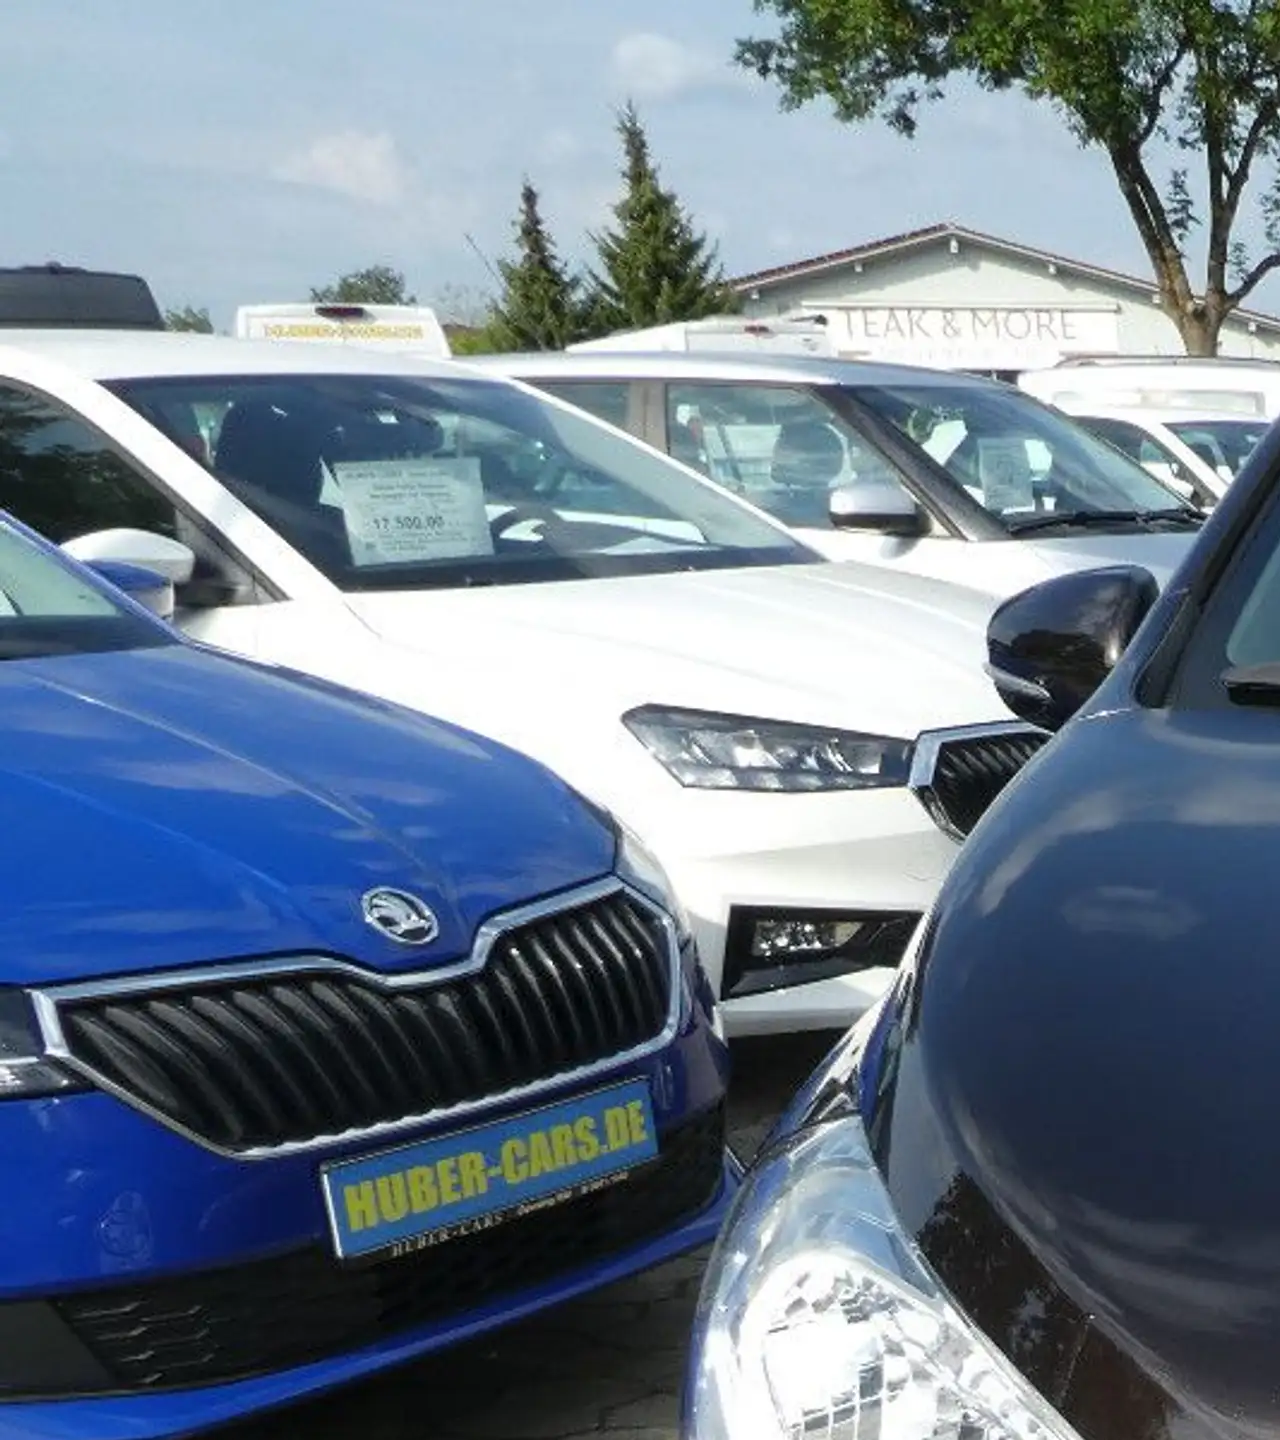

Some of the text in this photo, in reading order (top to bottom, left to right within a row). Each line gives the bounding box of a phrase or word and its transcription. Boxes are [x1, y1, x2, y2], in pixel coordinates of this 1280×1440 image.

[844, 308, 932, 338] TEAK
[971, 308, 1077, 340] MORE
[344, 1099, 649, 1232] HUBER-CARS.DE
